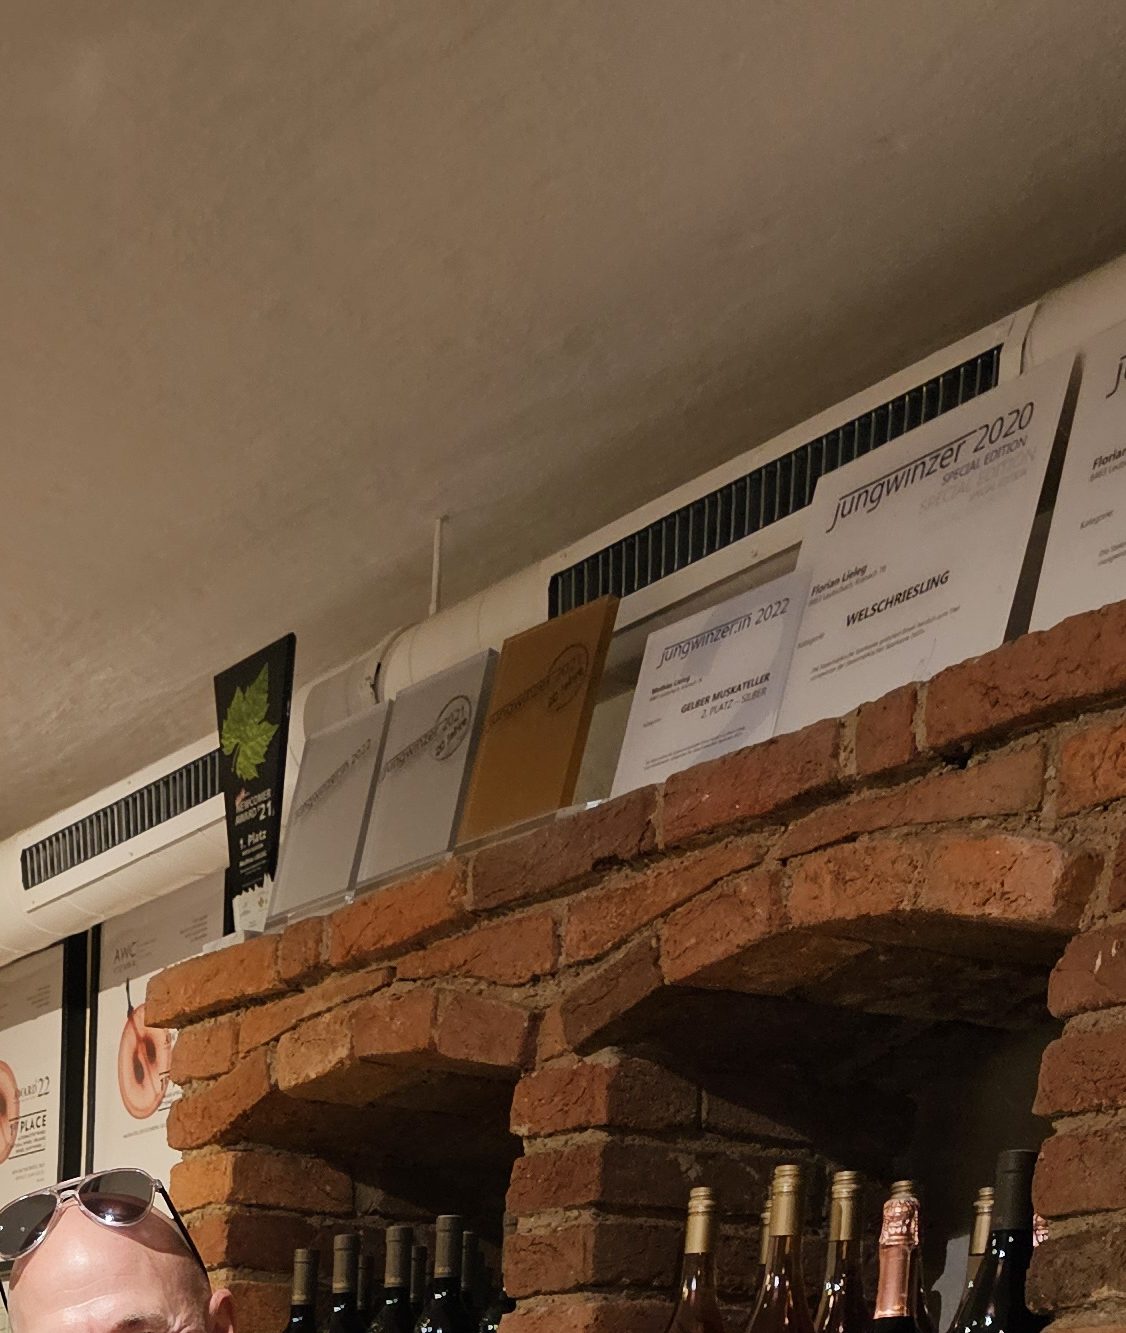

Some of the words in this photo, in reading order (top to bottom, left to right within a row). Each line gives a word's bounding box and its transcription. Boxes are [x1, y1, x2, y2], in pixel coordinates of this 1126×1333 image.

[826, 429, 975, 534] jungwinzer
[973, 400, 1036, 454] 2020
[941, 458, 982, 488] SPECIAL
[983, 434, 1029, 467] EDITION
[810, 575, 841, 597] Florian
[846, 569, 951, 628] WELSCHRIESLING
[754, 596, 791, 627] 2022
[680, 694, 711, 714] GELBER
[711, 671, 771, 704] MUSKATELLER
[19, 1114, 48, 1134] PLACE
